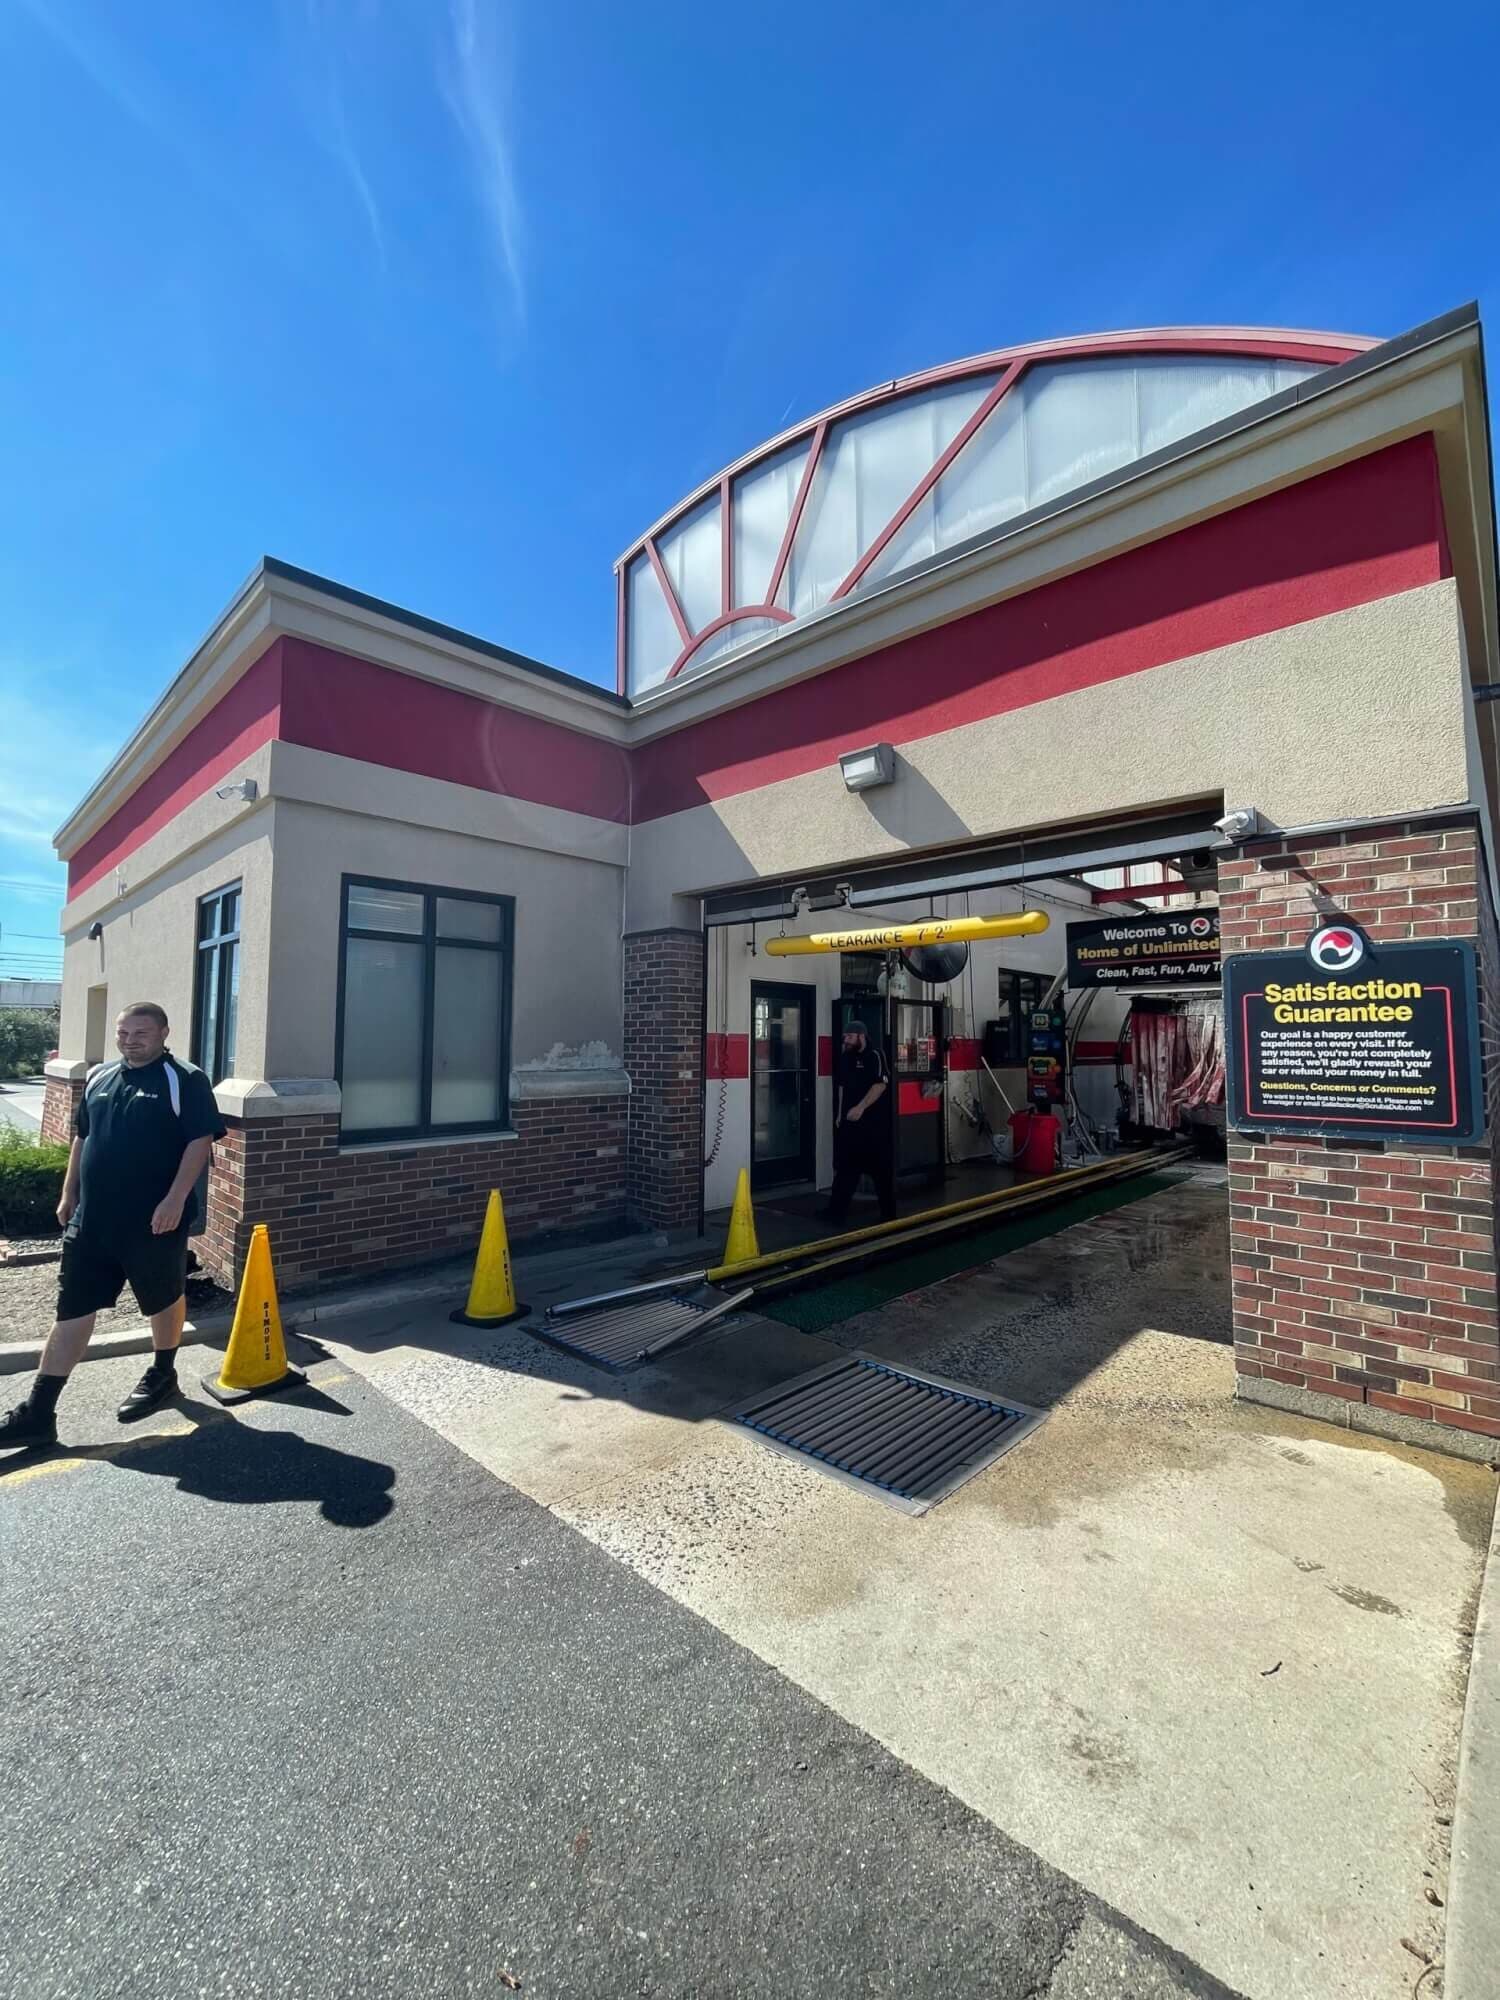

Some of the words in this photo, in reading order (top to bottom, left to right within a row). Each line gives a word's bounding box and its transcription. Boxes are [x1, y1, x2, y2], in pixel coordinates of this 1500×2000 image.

[820, 930, 904, 948] CLEARANCE
[1103, 927, 1166, 941] Welcome
[1169, 923, 1187, 935] To
[1077, 946, 1119, 960] Home
[1123, 944, 1138, 956] of
[1143, 937, 1220, 954] Unlimited
[1096, 967, 1129, 979] Clean,
[1132, 965, 1157, 976] Fast,
[1160, 964, 1184, 975] Fun,
[1187, 963, 1211, 975] Any
[1264, 979, 1422, 1003] Satisfaction
[1274, 1003, 1413, 1024] Guarantee
[1260, 1031, 1279, 1039] Our
[1280, 1030, 1301, 1040] goal
[1302, 1030, 1312, 1038] is
[1321, 1030, 1354, 1040] happy
[1355, 1030, 1407, 1038] customer
[1260, 1040, 1313, 1049] experience
[1329, 1041, 1358, 1049] every
[1360, 1040, 1385, 1048] visit.
[1387, 1040, 1396, 1048] If
[1397, 1040, 1415, 1048] for
[1261, 1050, 1278, 1058] any
[1280, 1050, 1316, 1058] reason,
[1317, 1049, 1349, 1058] you're
[1351, 1049, 1369, 1057] not
[1370, 1049, 1432, 1060] completely
[1261, 1058, 1305, 1067] satisfied,
[1306, 1058, 1329, 1066] we'll
[1330, 1058, 1362, 1068] gladly
[1364, 1059, 1404, 1068] rewash
[1406, 1060, 1433, 1069] your
[1291, 1067, 1323, 1075] refund
[1325, 1068, 1348, 1077] your
[1350, 1069, 1386, 1079] money
[1388, 1068, 1399, 1077] in
[1400, 1069, 1422, 1078] full.
[1260, 1081, 1309, 1091] Questions,
[1310, 1082, 1357, 1092] Concerns
[1371, 1084, 1437, 1094] Comments?
